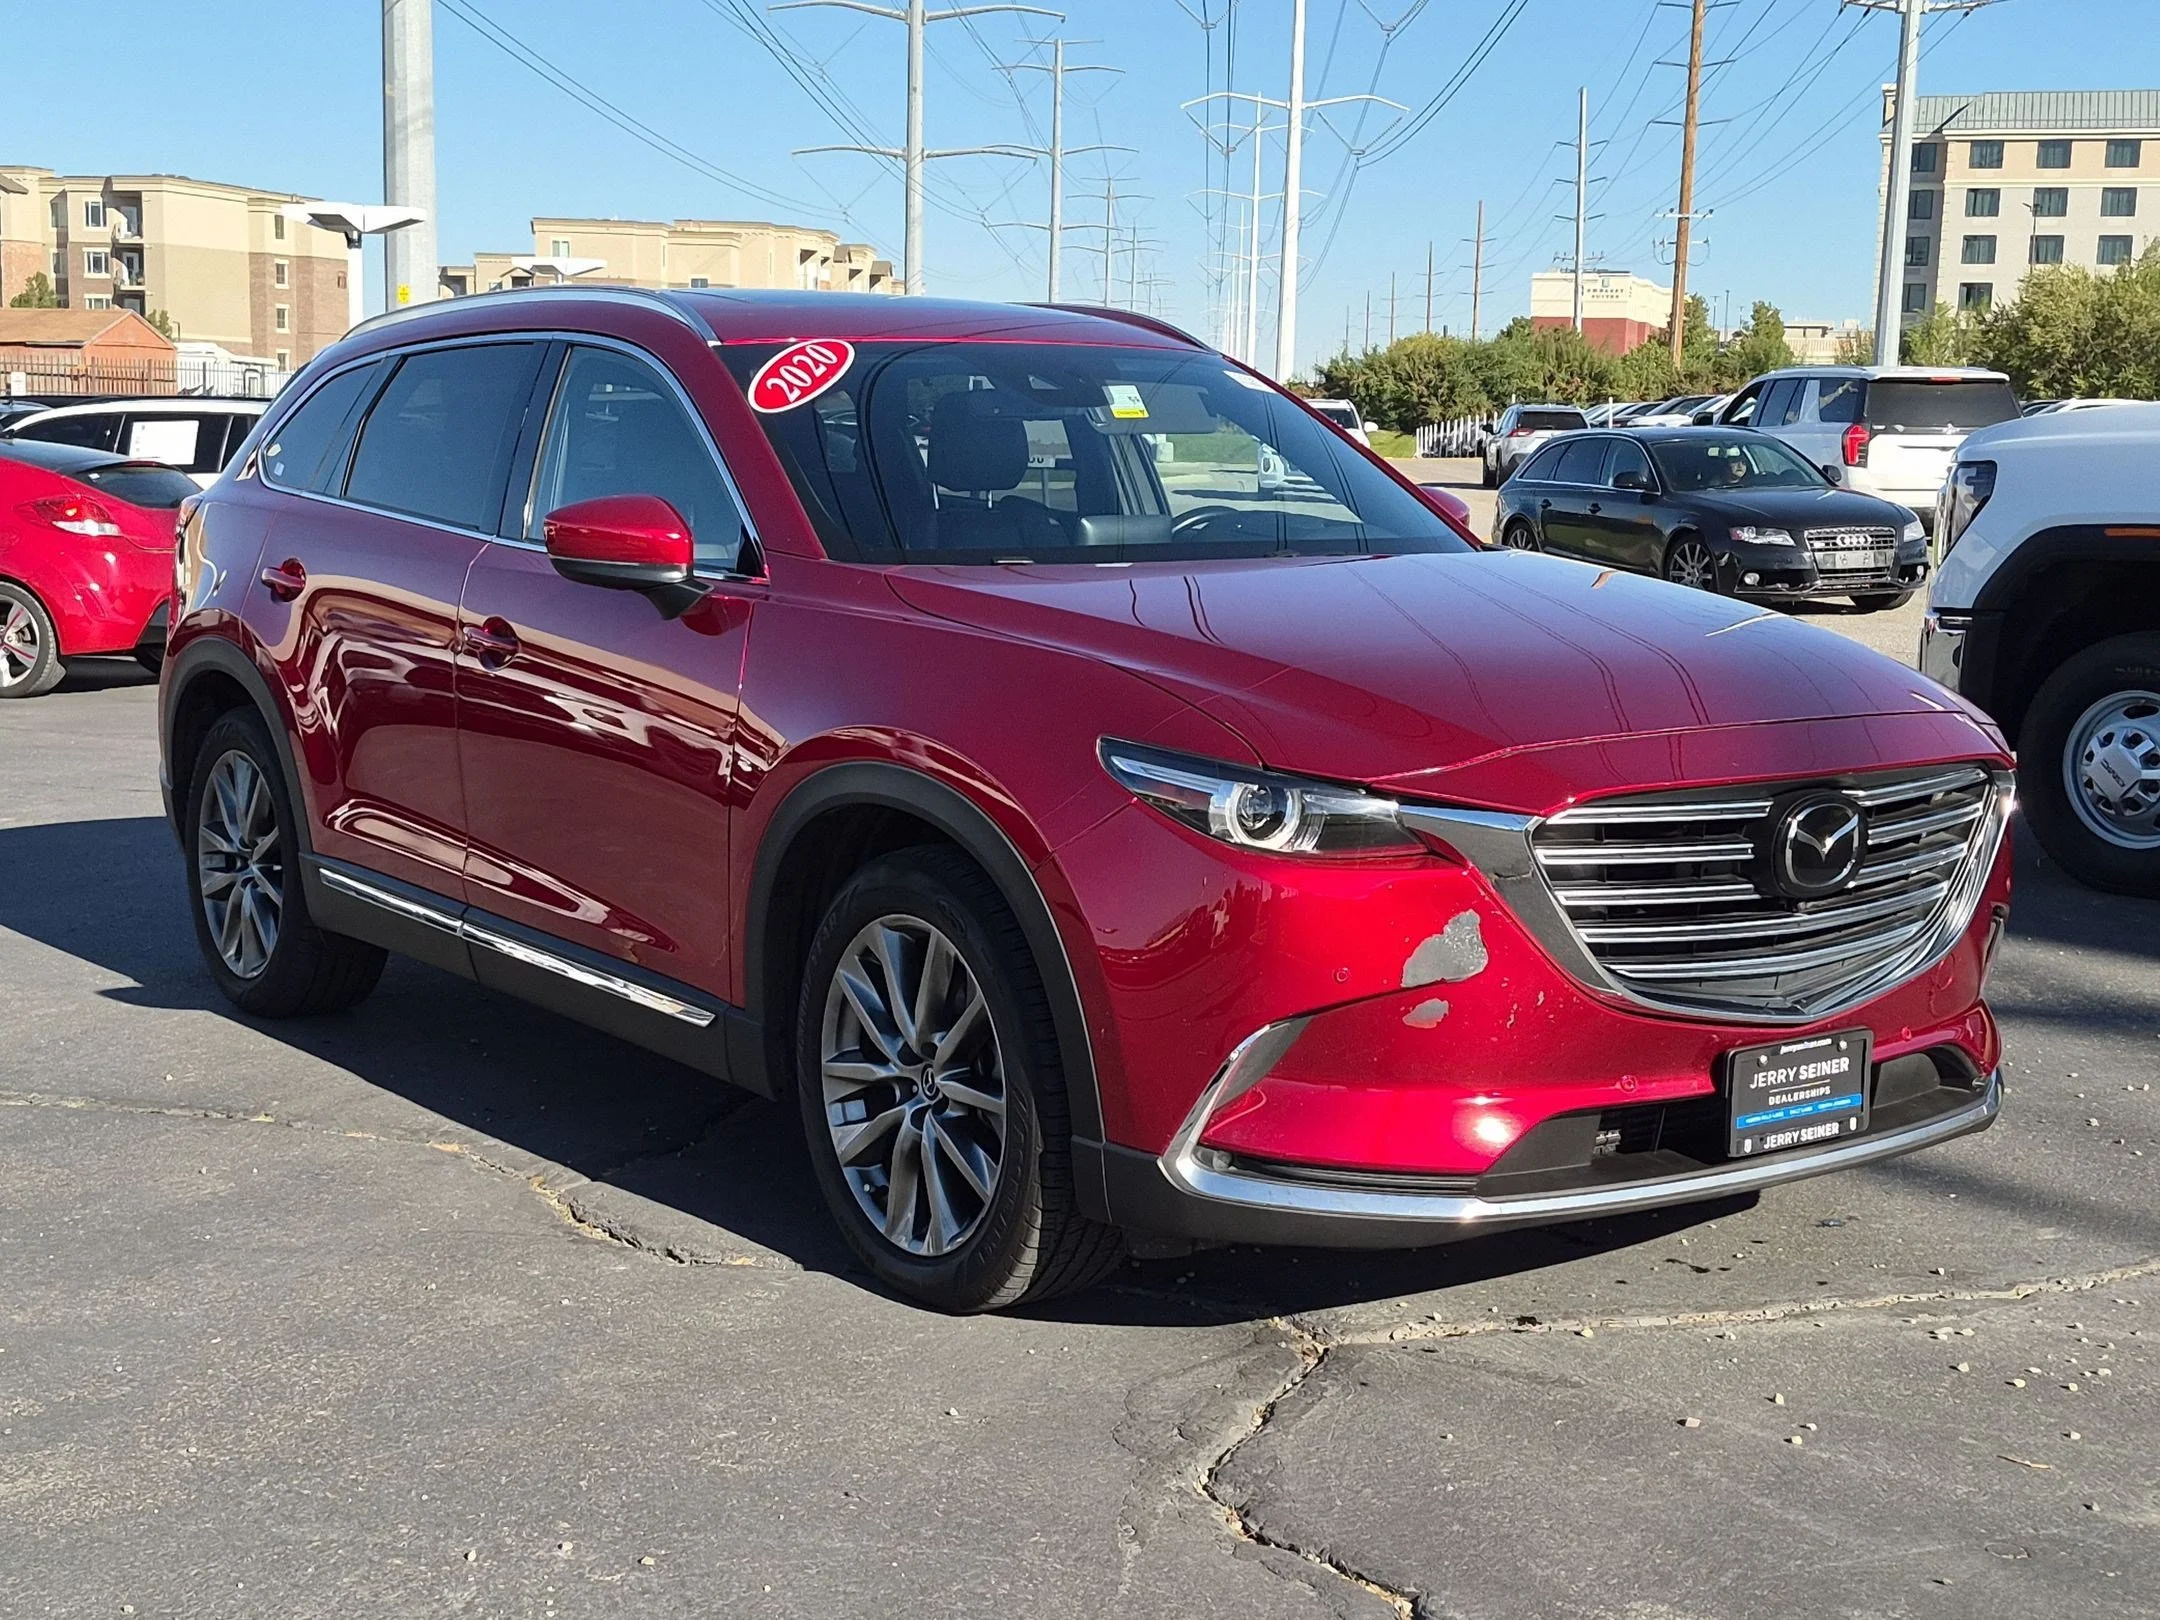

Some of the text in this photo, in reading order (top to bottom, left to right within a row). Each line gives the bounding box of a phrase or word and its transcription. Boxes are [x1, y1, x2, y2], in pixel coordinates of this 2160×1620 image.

[765, 344, 838, 403] 2020
[1749, 1057, 1850, 1089] JERRY SEINER
[1768, 1086, 1831, 1106] DEALERSHIPS
[1763, 1121, 1840, 1150] JERRY SEINER
